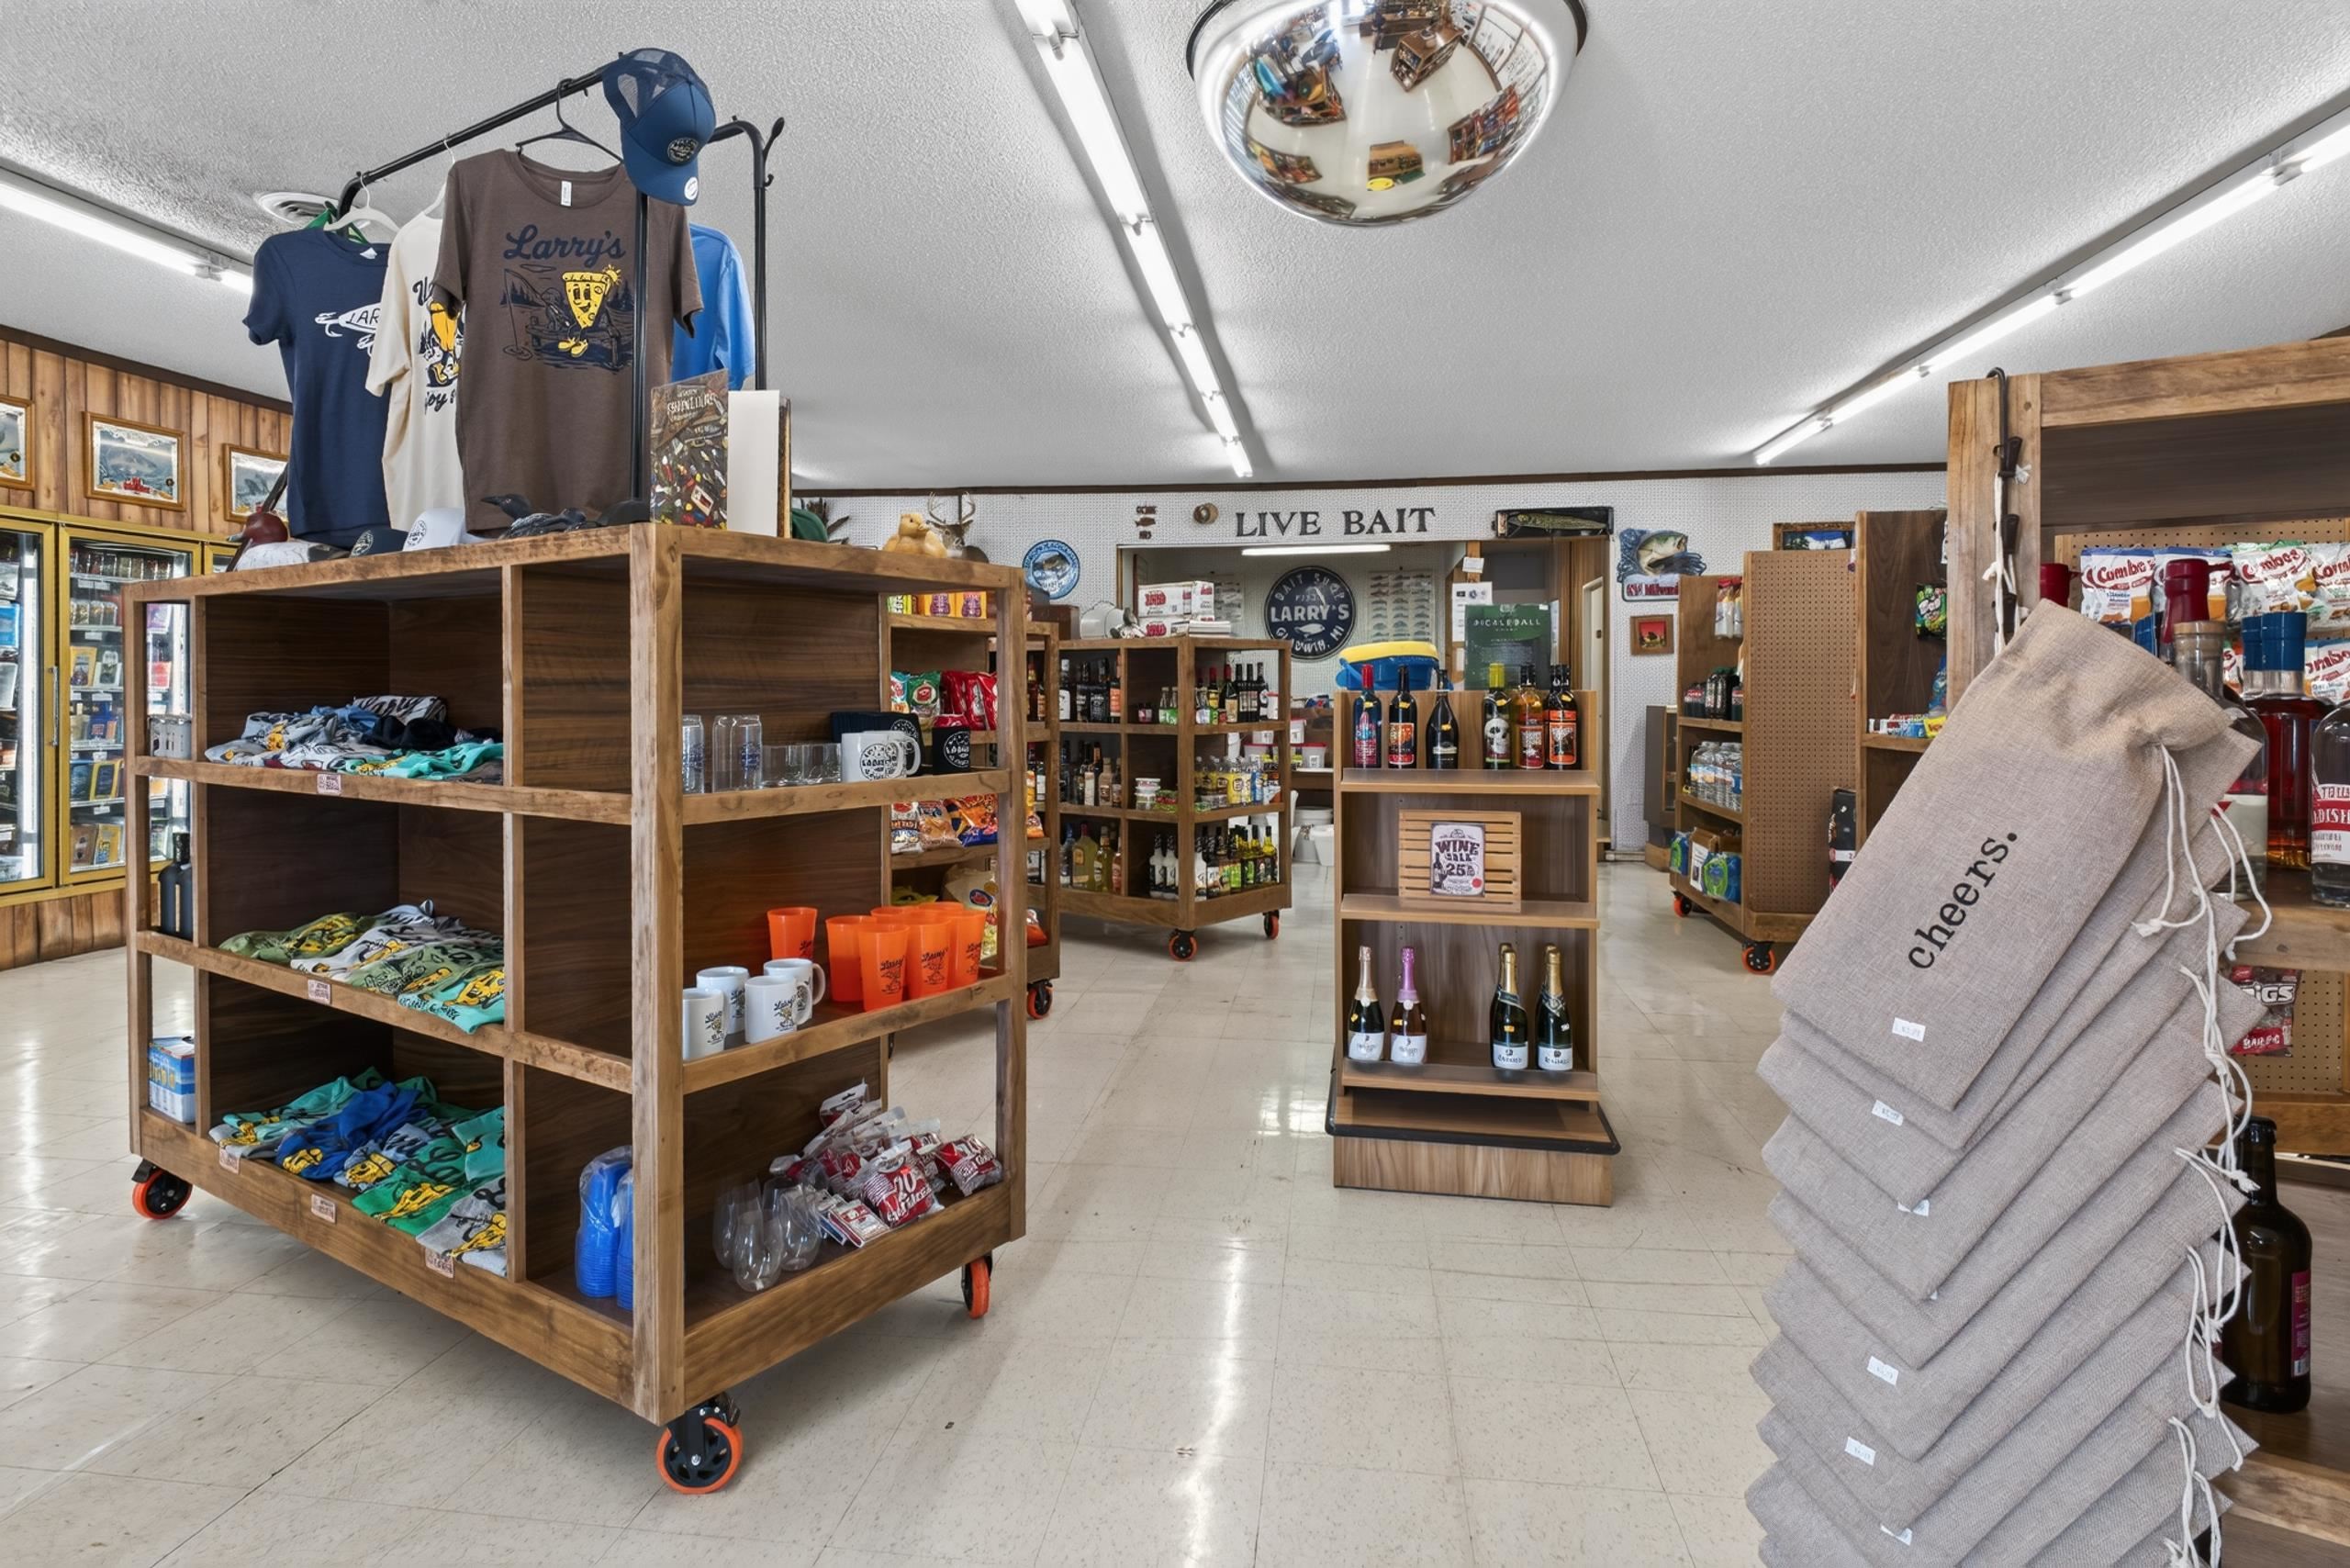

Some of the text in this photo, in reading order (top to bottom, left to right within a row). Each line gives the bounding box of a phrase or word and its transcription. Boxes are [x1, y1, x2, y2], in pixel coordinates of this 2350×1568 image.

[503, 224, 626, 269] Larry's
[1236, 507, 1437, 538] LIVE BAIT
[1275, 574, 1303, 601] BAIT
[1270, 603, 1349, 623] LARRY'S
[1435, 839, 1480, 856] WINE
[1908, 832, 2019, 969] cheers.
